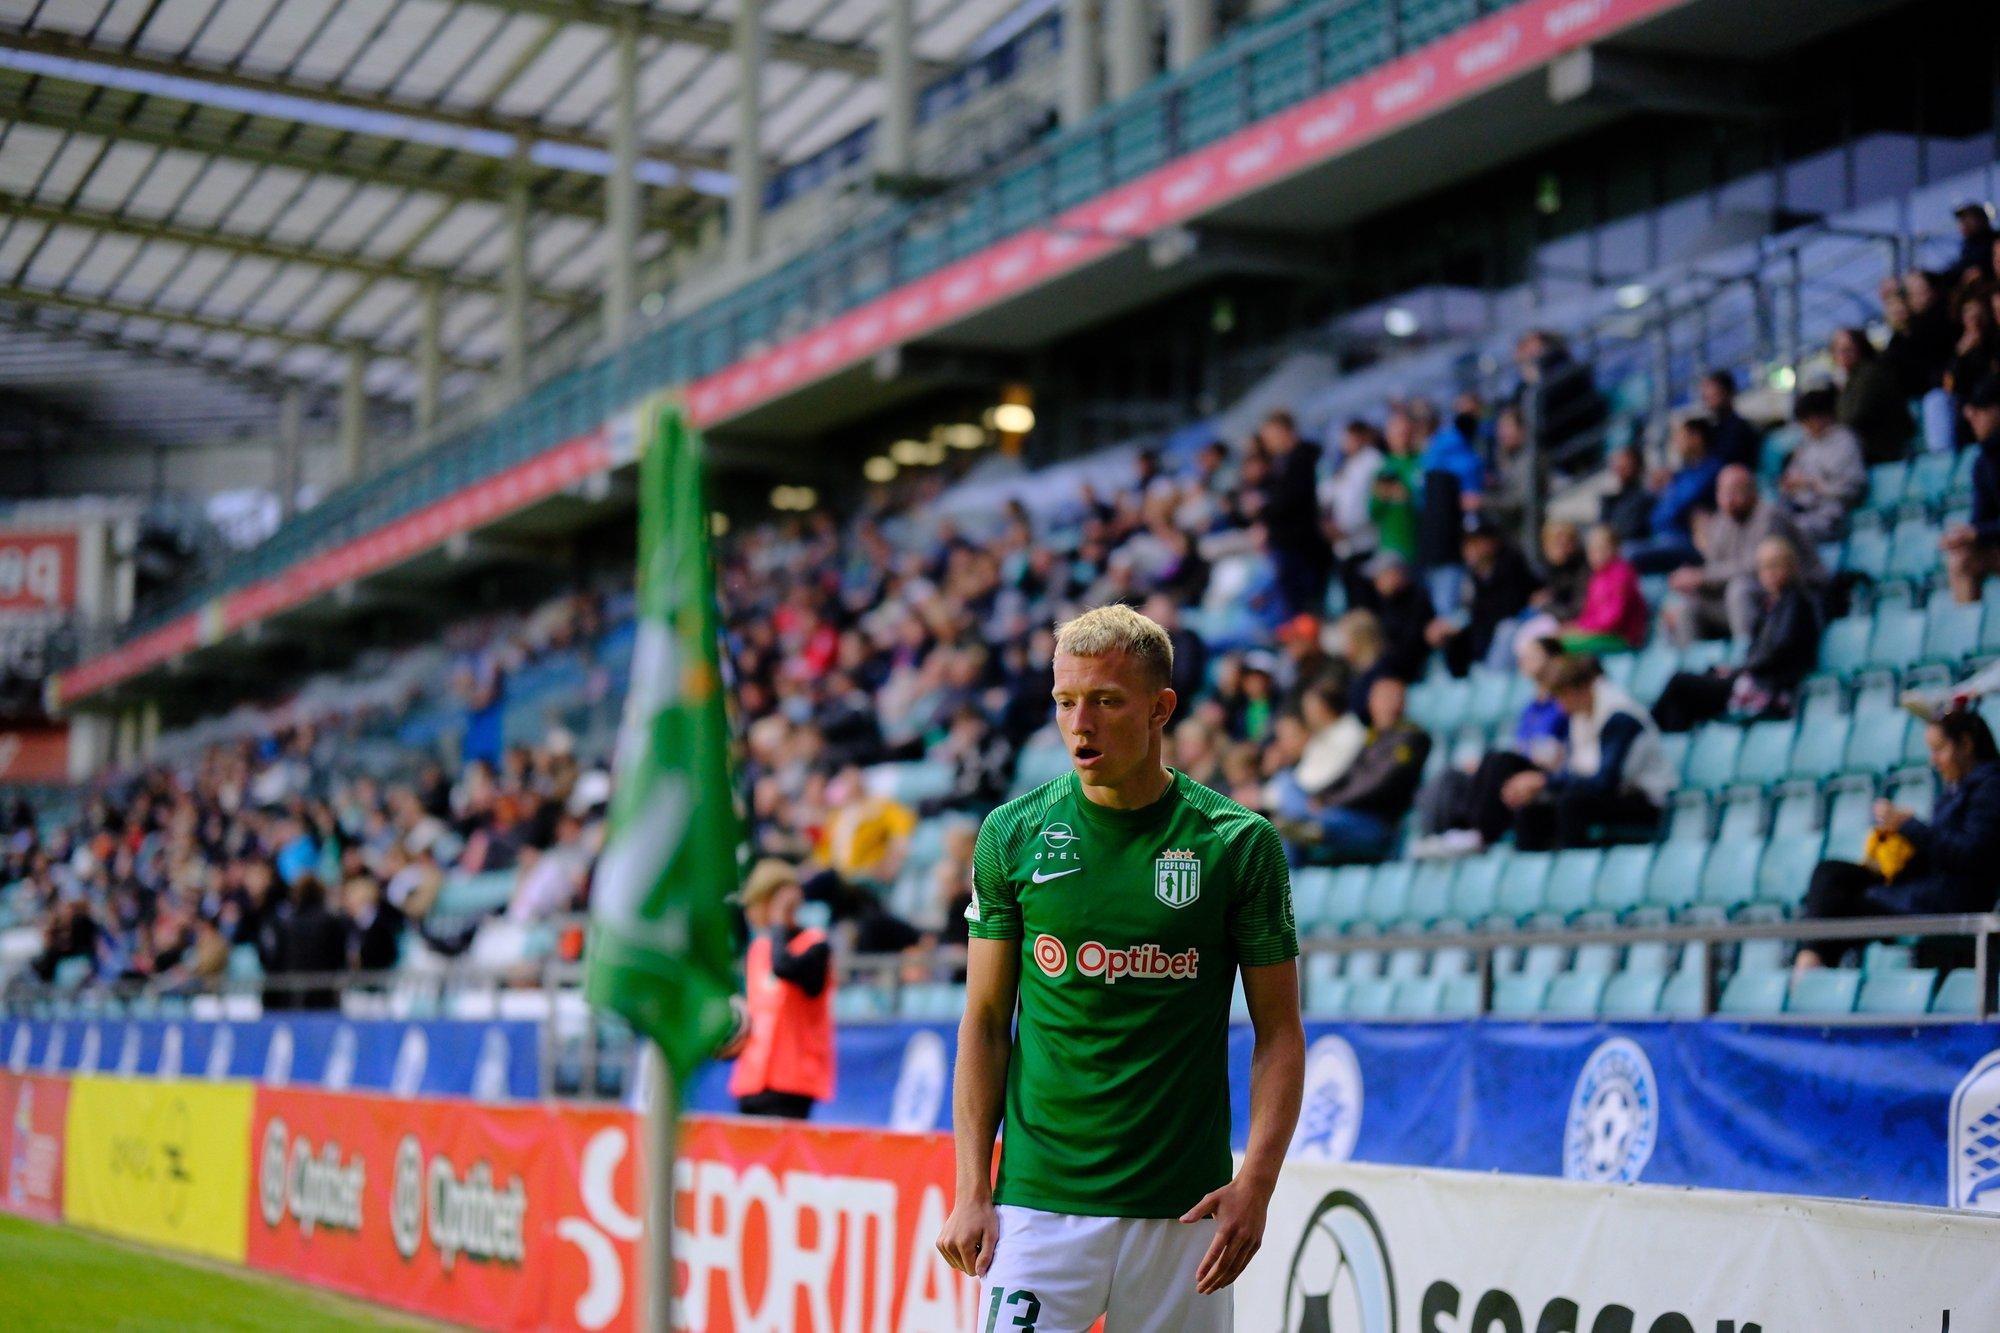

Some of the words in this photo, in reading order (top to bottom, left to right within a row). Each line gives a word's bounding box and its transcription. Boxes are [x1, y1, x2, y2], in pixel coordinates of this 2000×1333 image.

[1034, 852, 1080, 860] OPEL
[1077, 942, 1199, 983] Optibet
[671, 1157, 979, 1333] SPORTLA
[985, 1286, 1042, 1333] 13
